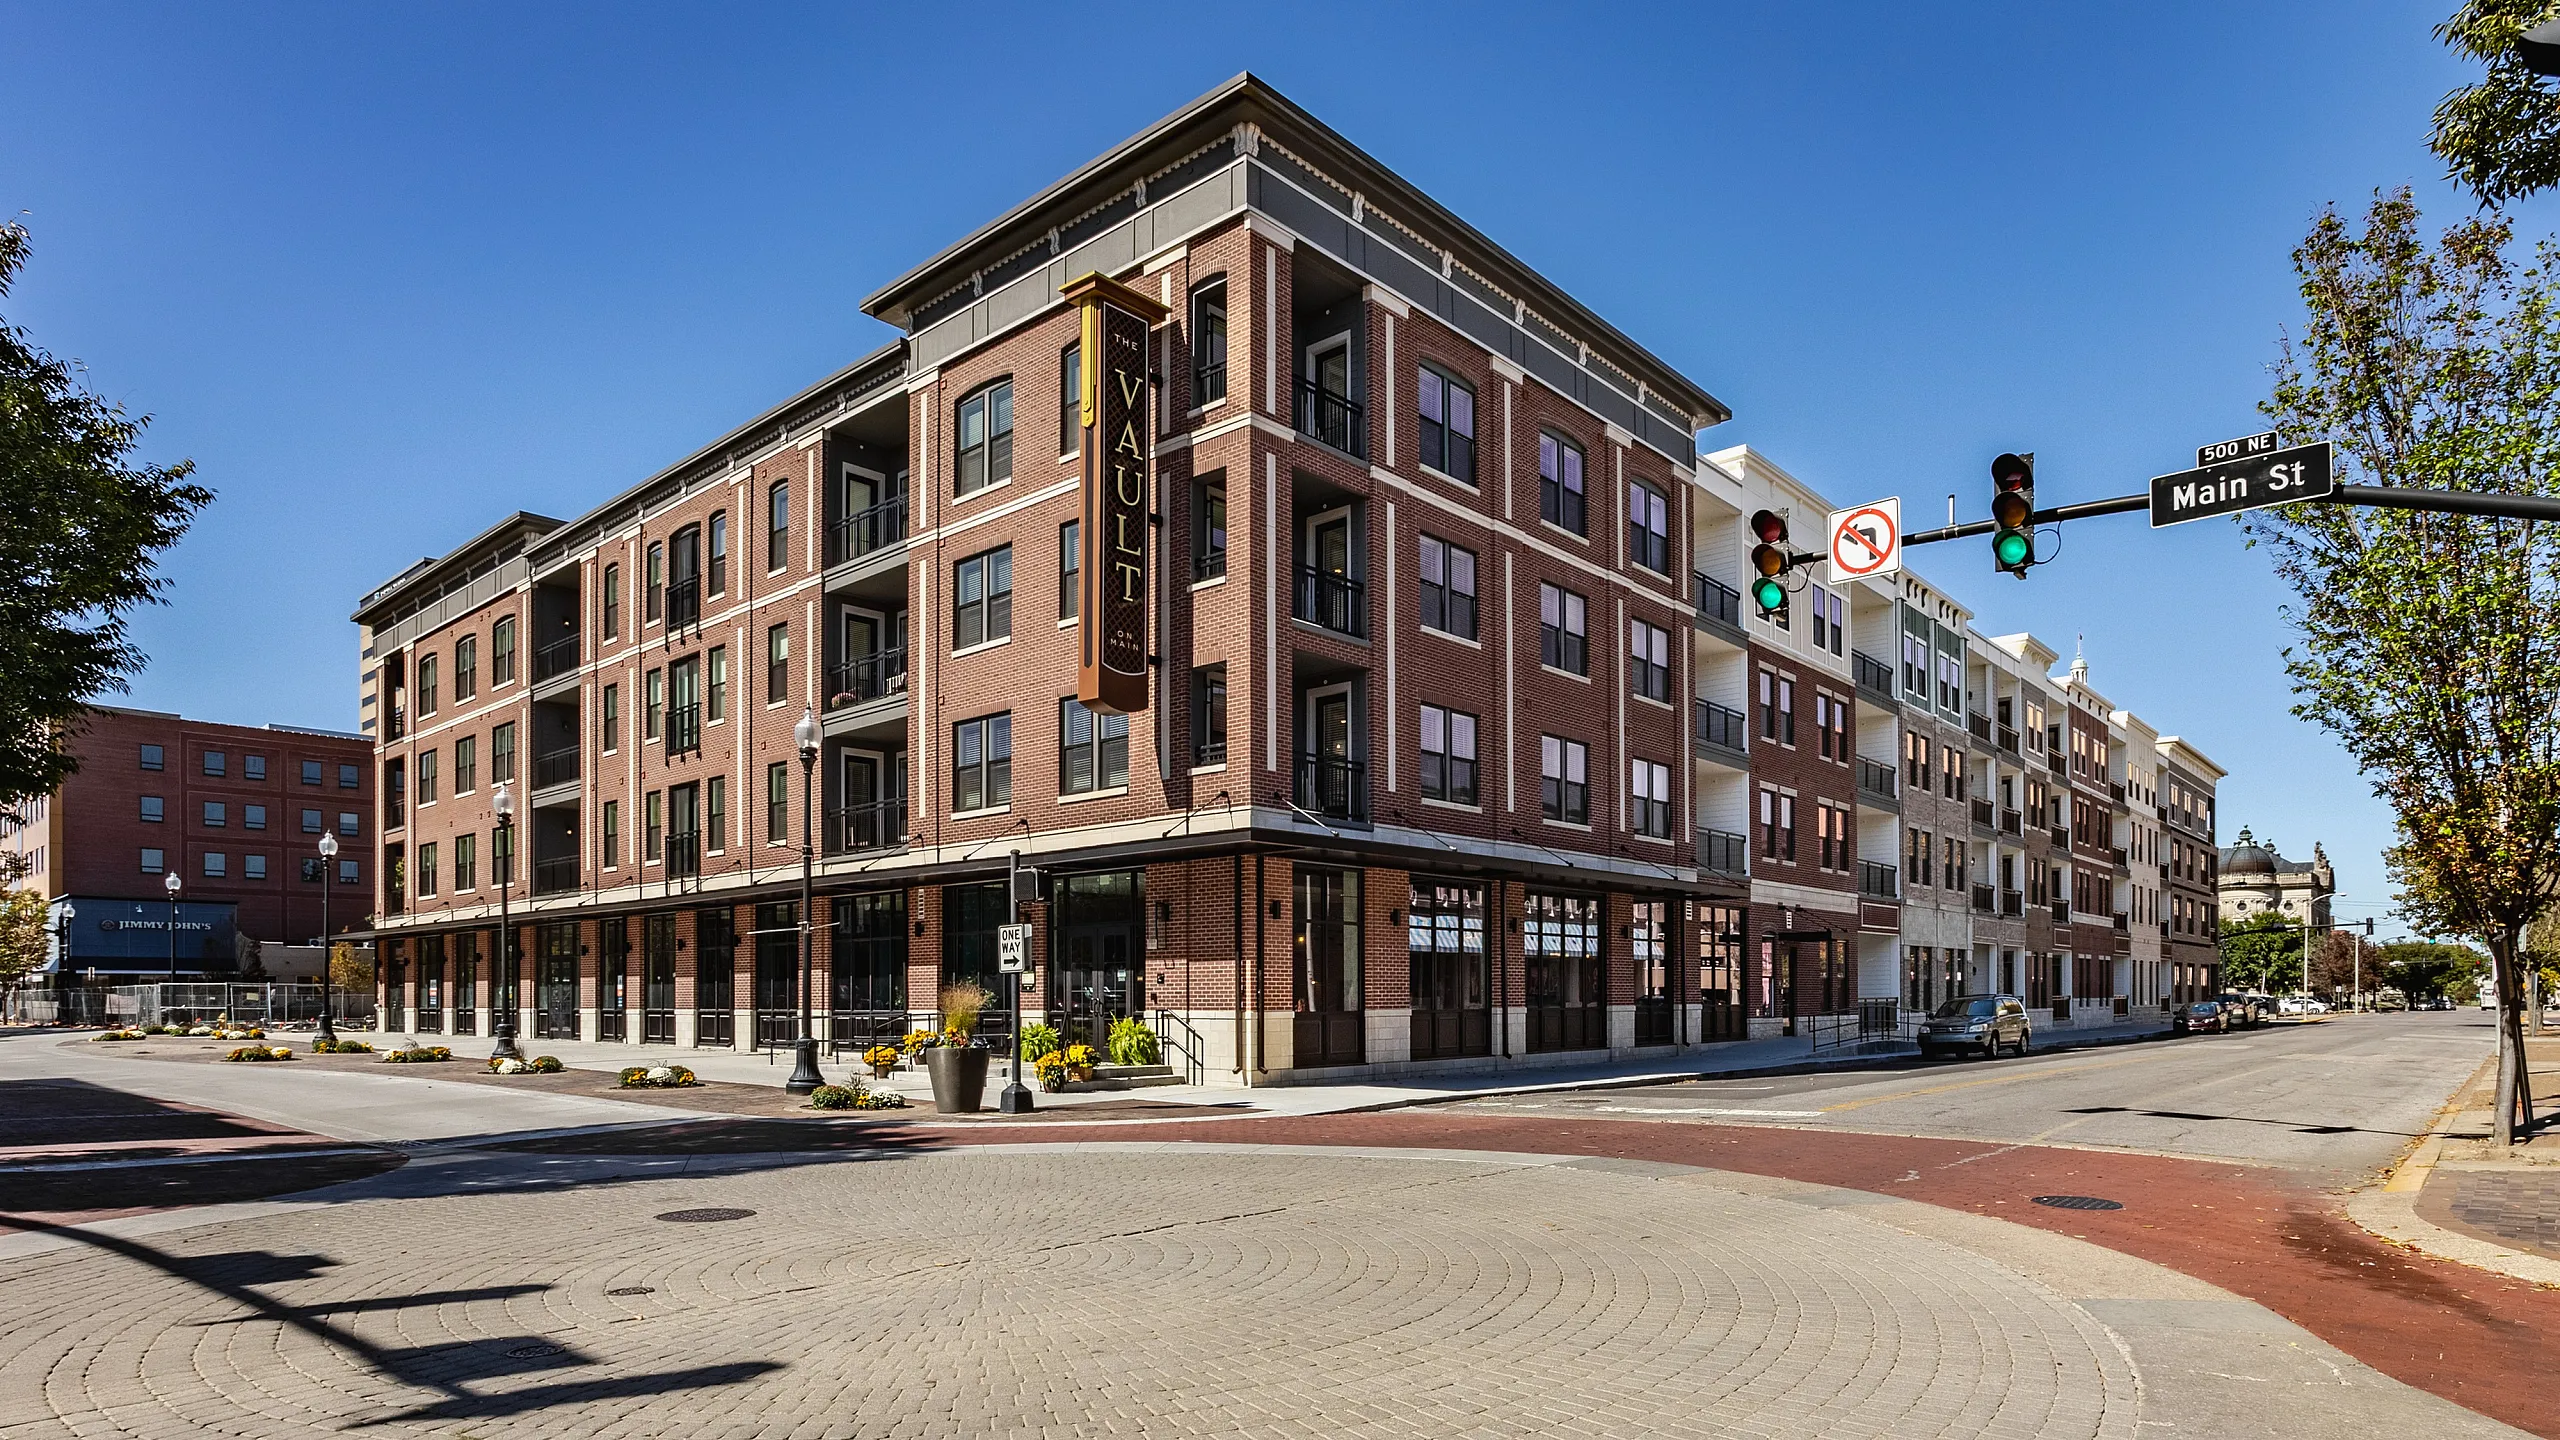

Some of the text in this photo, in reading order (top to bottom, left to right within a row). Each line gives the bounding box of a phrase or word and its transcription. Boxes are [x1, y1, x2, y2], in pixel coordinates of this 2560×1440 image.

[1114, 333, 1138, 351] THE
[2204, 434, 2271, 462] 500 NE
[1114, 368, 1144, 602] VAULT
[2172, 460, 2306, 512] Main St
[1117, 630, 1132, 640] ON
[1110, 638, 1139, 651] MAIN
[119, 920, 212, 931] JIMMY JOHN'S
[1002, 929, 1020, 941] ONE
[1002, 942, 1021, 953] WAY
